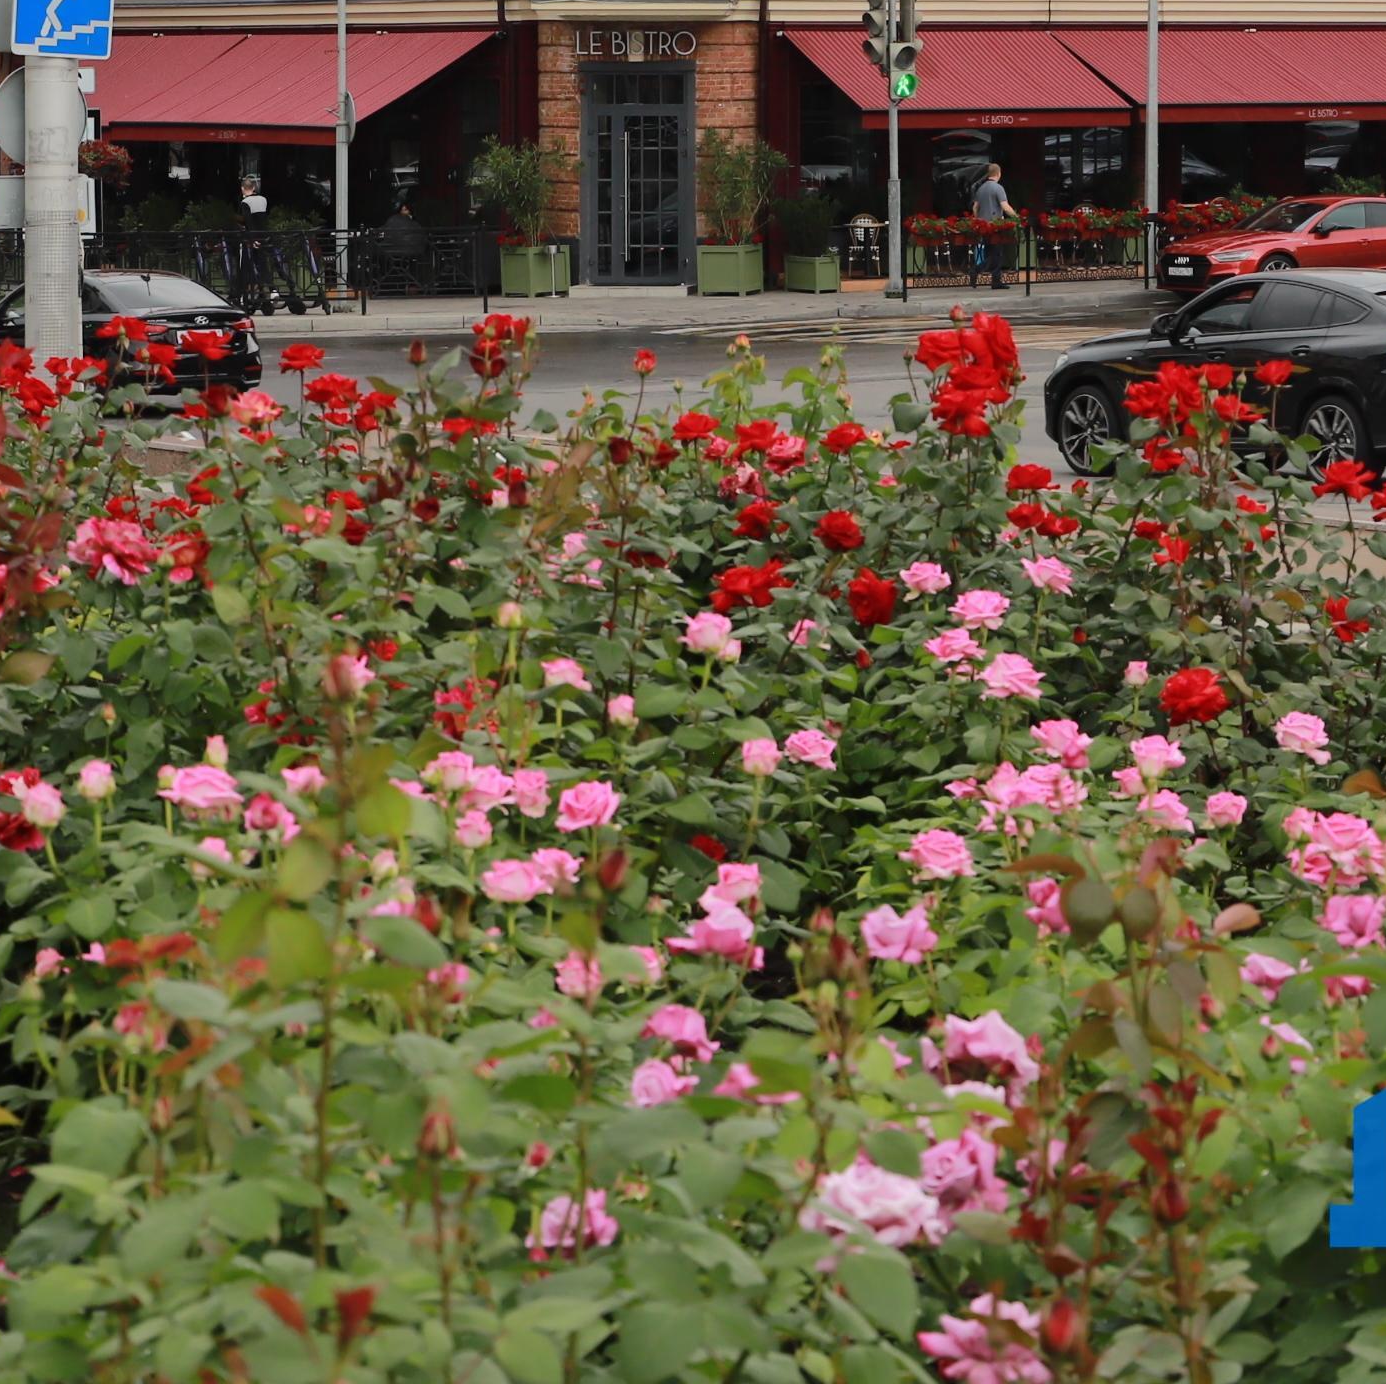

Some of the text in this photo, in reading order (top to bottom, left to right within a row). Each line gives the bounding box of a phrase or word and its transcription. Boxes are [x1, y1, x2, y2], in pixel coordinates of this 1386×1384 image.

[576, 31, 696, 55] LE BISTRO
[1308, 109, 1339, 117] LE BISTRO
[981, 116, 990, 124] LE
